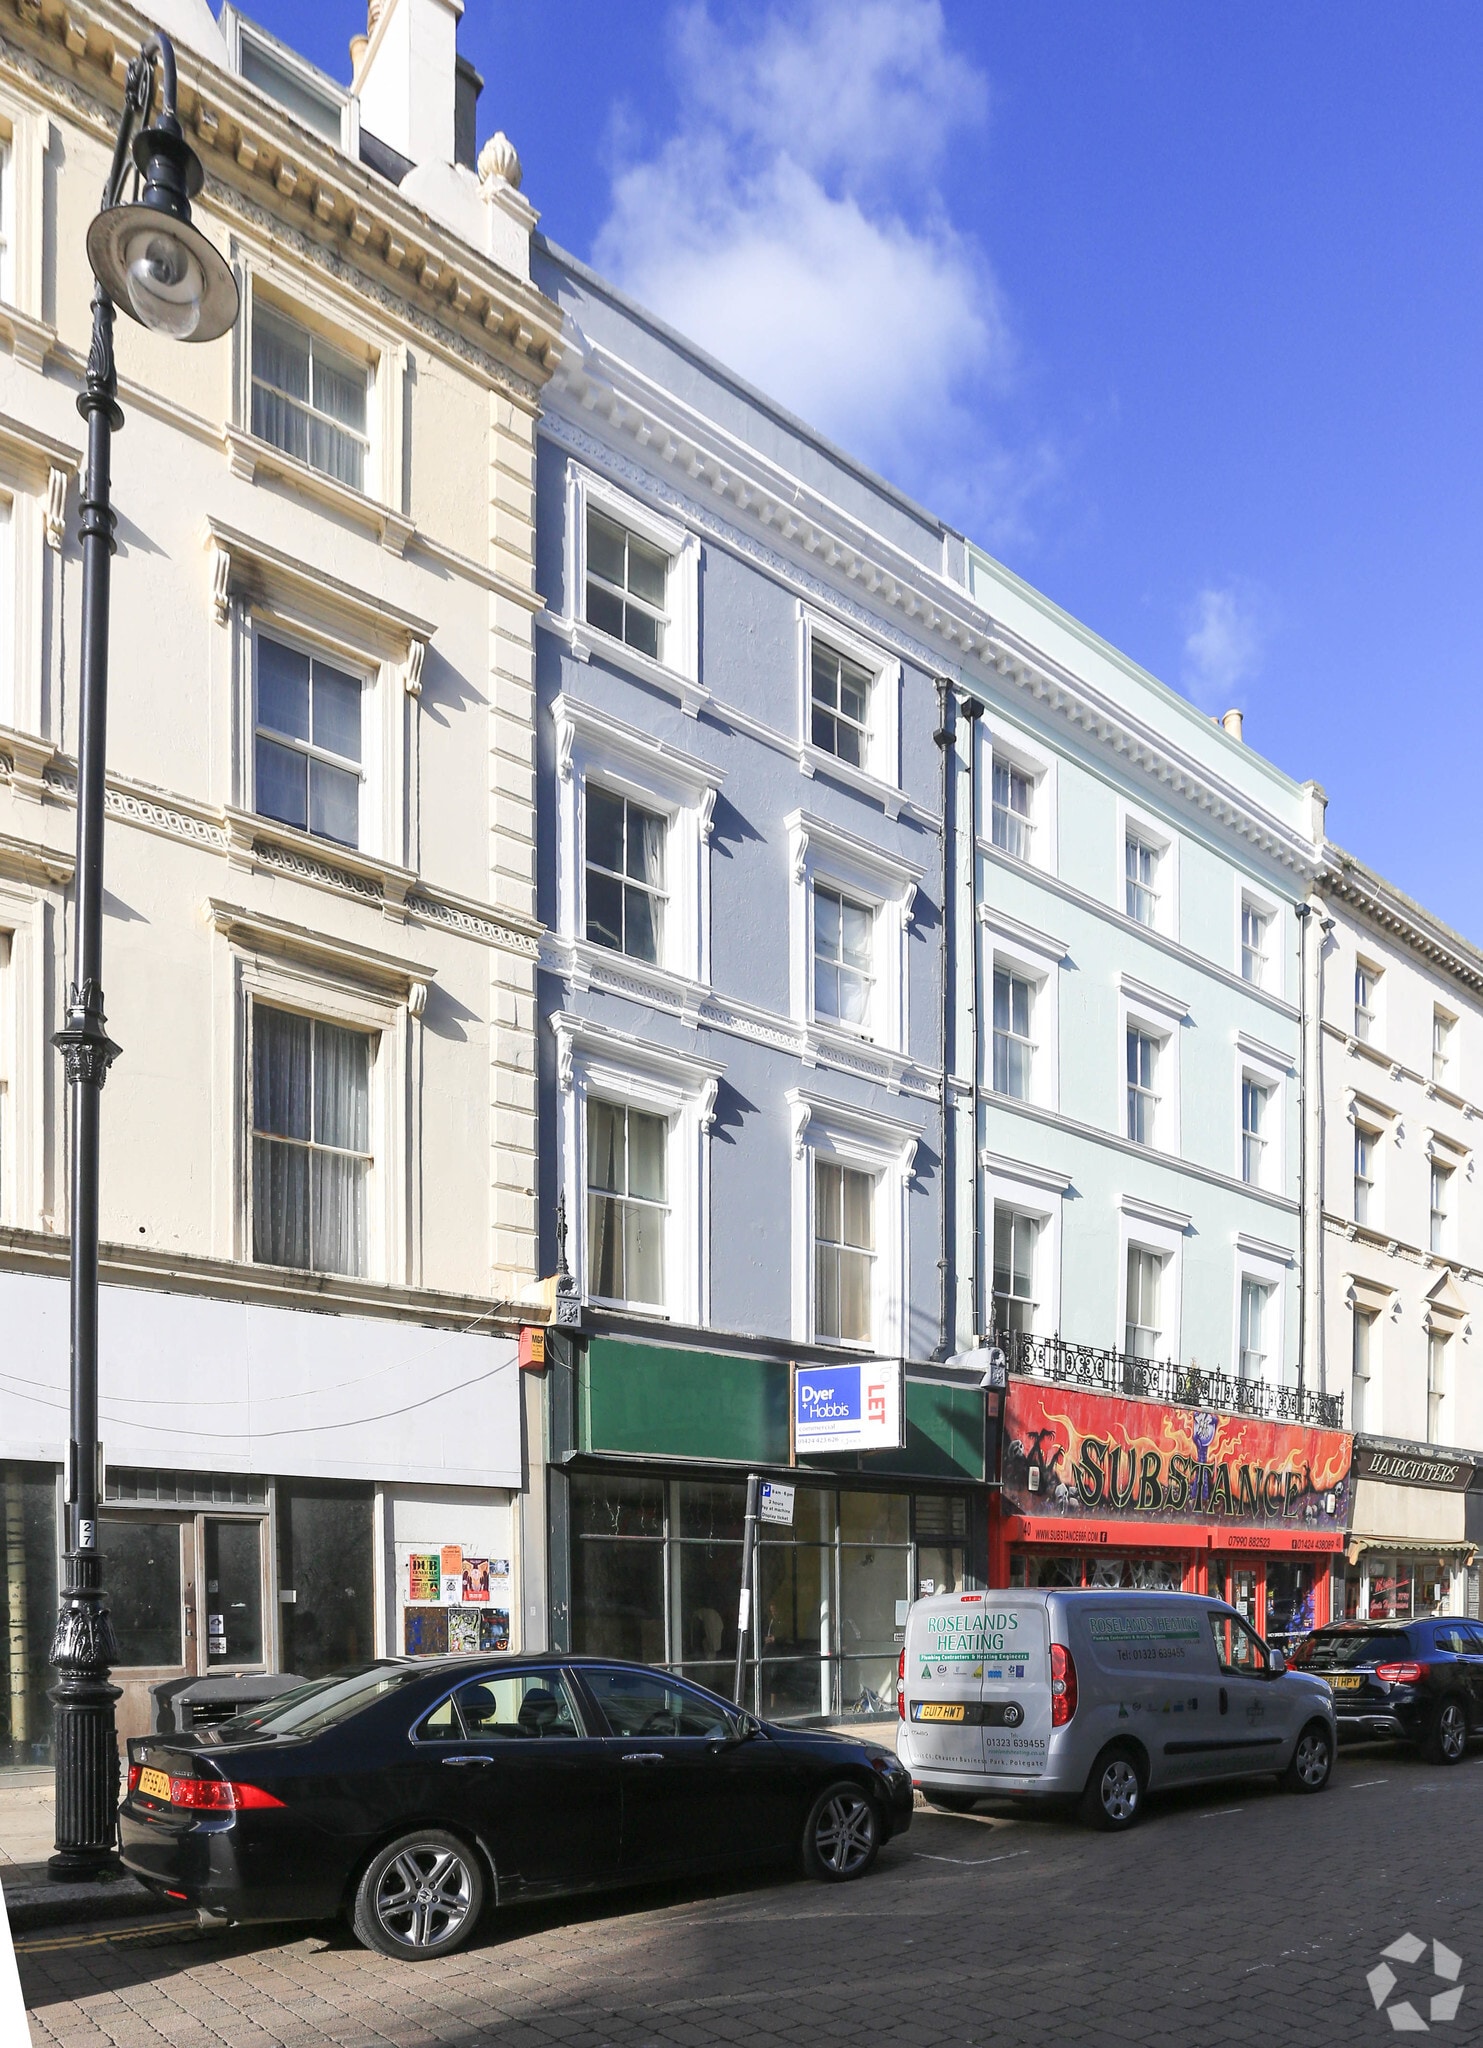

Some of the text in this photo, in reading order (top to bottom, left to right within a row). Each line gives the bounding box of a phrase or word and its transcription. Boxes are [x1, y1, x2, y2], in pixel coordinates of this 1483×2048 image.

[802, 1386, 834, 1405] Dyer
[810, 1402, 849, 1418] Hobbis
[868, 1384, 885, 1424] LET
[799, 1424, 835, 1432] commercial
[1368, 1453, 1459, 1482] HAIRCUTTERS
[1073, 1439, 1301, 1518] SUBSTANCE
[1228, 1536, 1247, 1546] 07990
[1248, 1538, 1270, 1548] 882523
[412, 1560, 438, 1571] DUB
[928, 1613, 1018, 1633] ROSELANDS
[1089, 1616, 1199, 1633] ROSELANDS HEATING
[938, 1634, 1004, 1651] HEATING
[1117, 1648, 1185, 1660] Tel: 01323 639455
[1340, 1676, 1358, 1686] HPY
[924, 1704, 962, 1718] GU17 HWT
[986, 1738, 1045, 1748] 01323 639455
